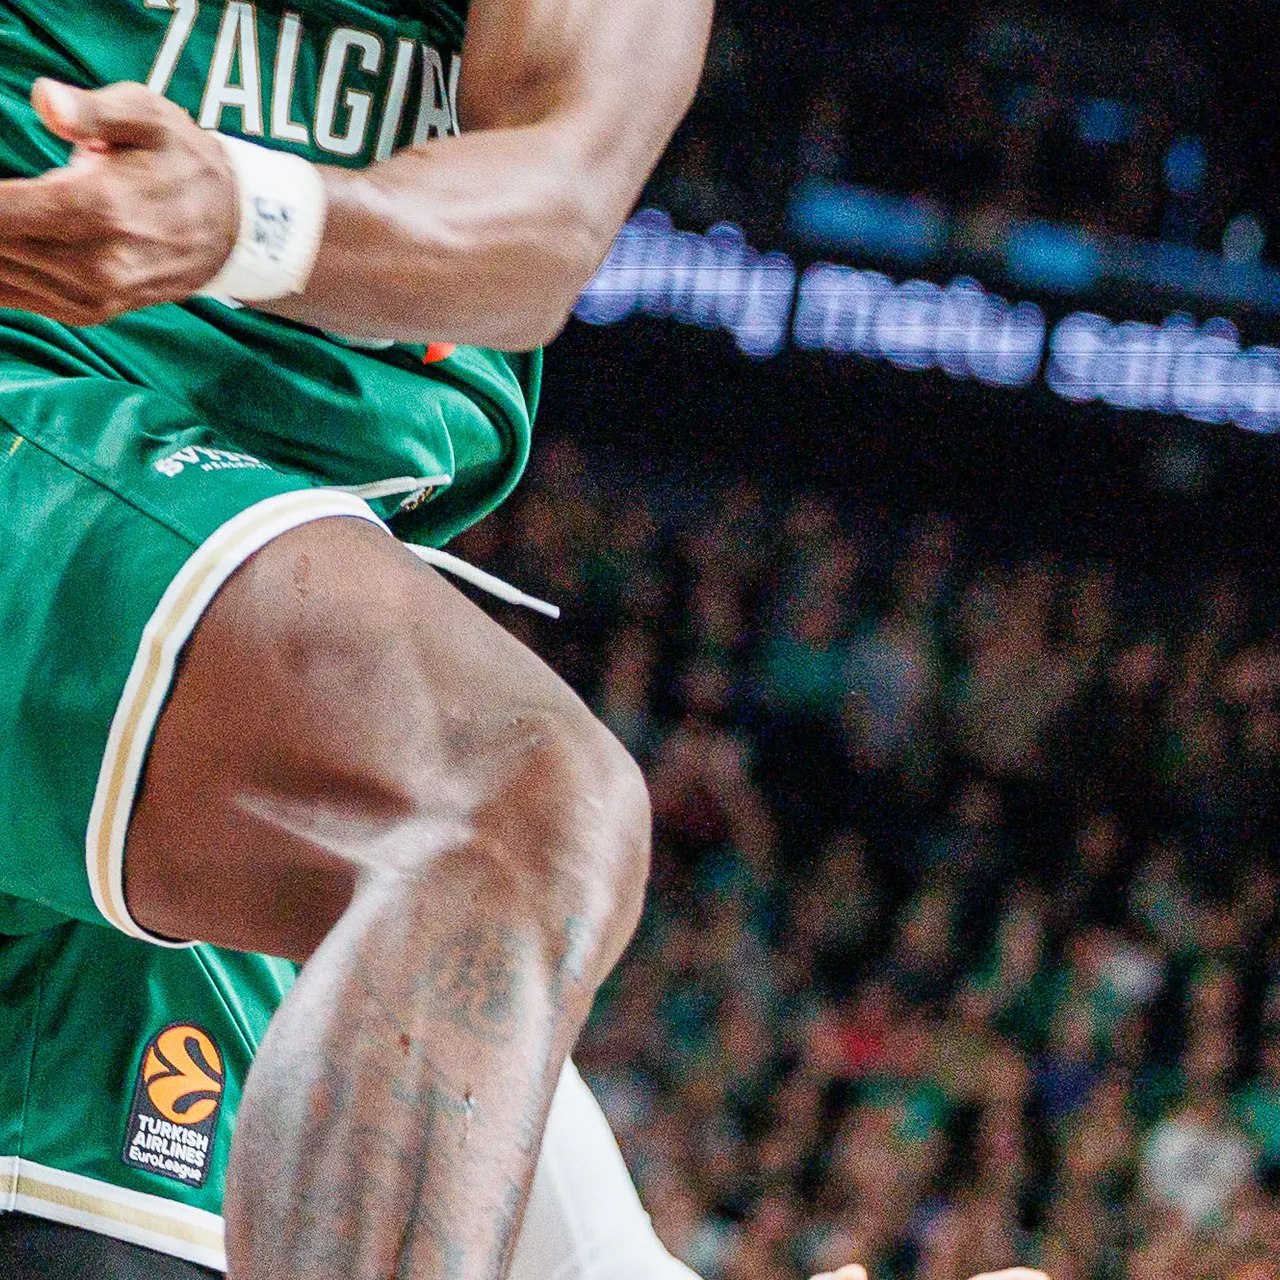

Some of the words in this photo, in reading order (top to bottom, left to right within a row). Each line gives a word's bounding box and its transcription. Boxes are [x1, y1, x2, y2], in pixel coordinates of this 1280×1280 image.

[132, 1130, 206, 1167] AIRLINES
[138, 1113, 209, 1153] TURKISH
[128, 1145, 202, 1181] EuroLeague
